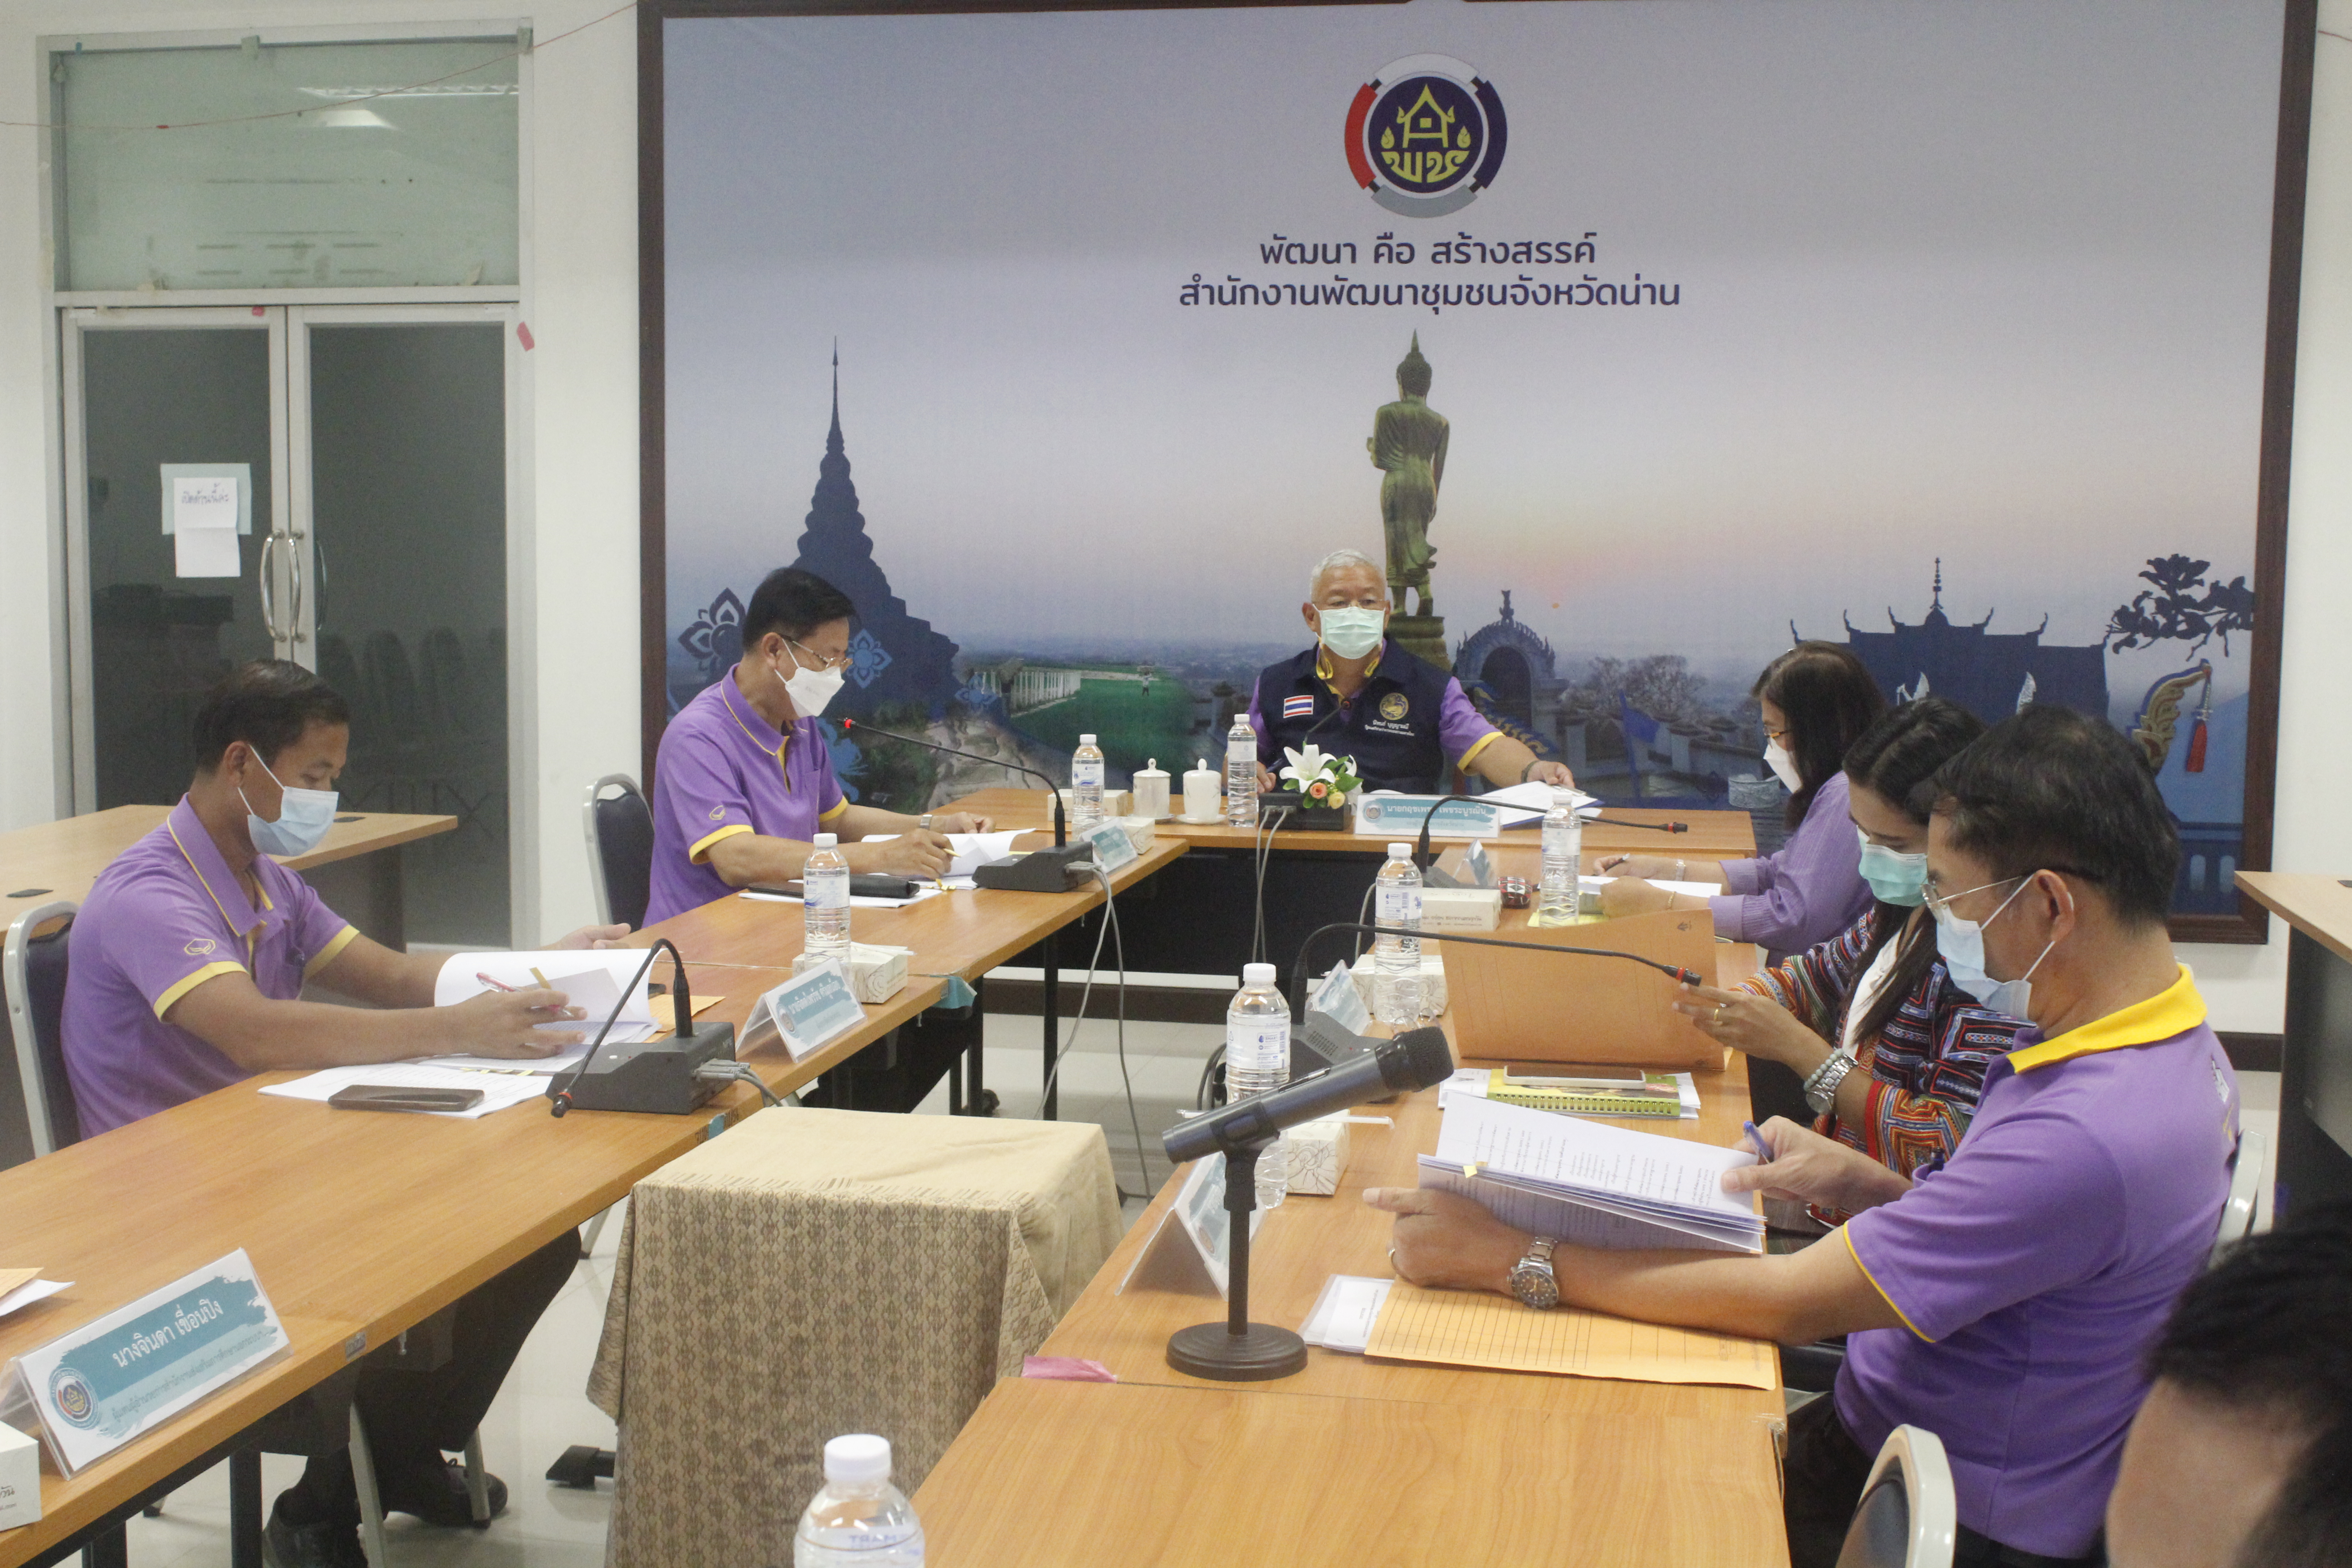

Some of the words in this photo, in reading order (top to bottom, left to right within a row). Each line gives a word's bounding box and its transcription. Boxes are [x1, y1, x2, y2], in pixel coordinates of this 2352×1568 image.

[1260, 233, 1357, 265] พัฒนา
[1373, 232, 1415, 265] คือ
[1431, 232, 1597, 265] สร้างสรรค์
[1179, 273, 1680, 315] สำนักงานพัฒนาชุมชนจังหวัดน่าน
[113, 1326, 176, 1367] นางจินดา
